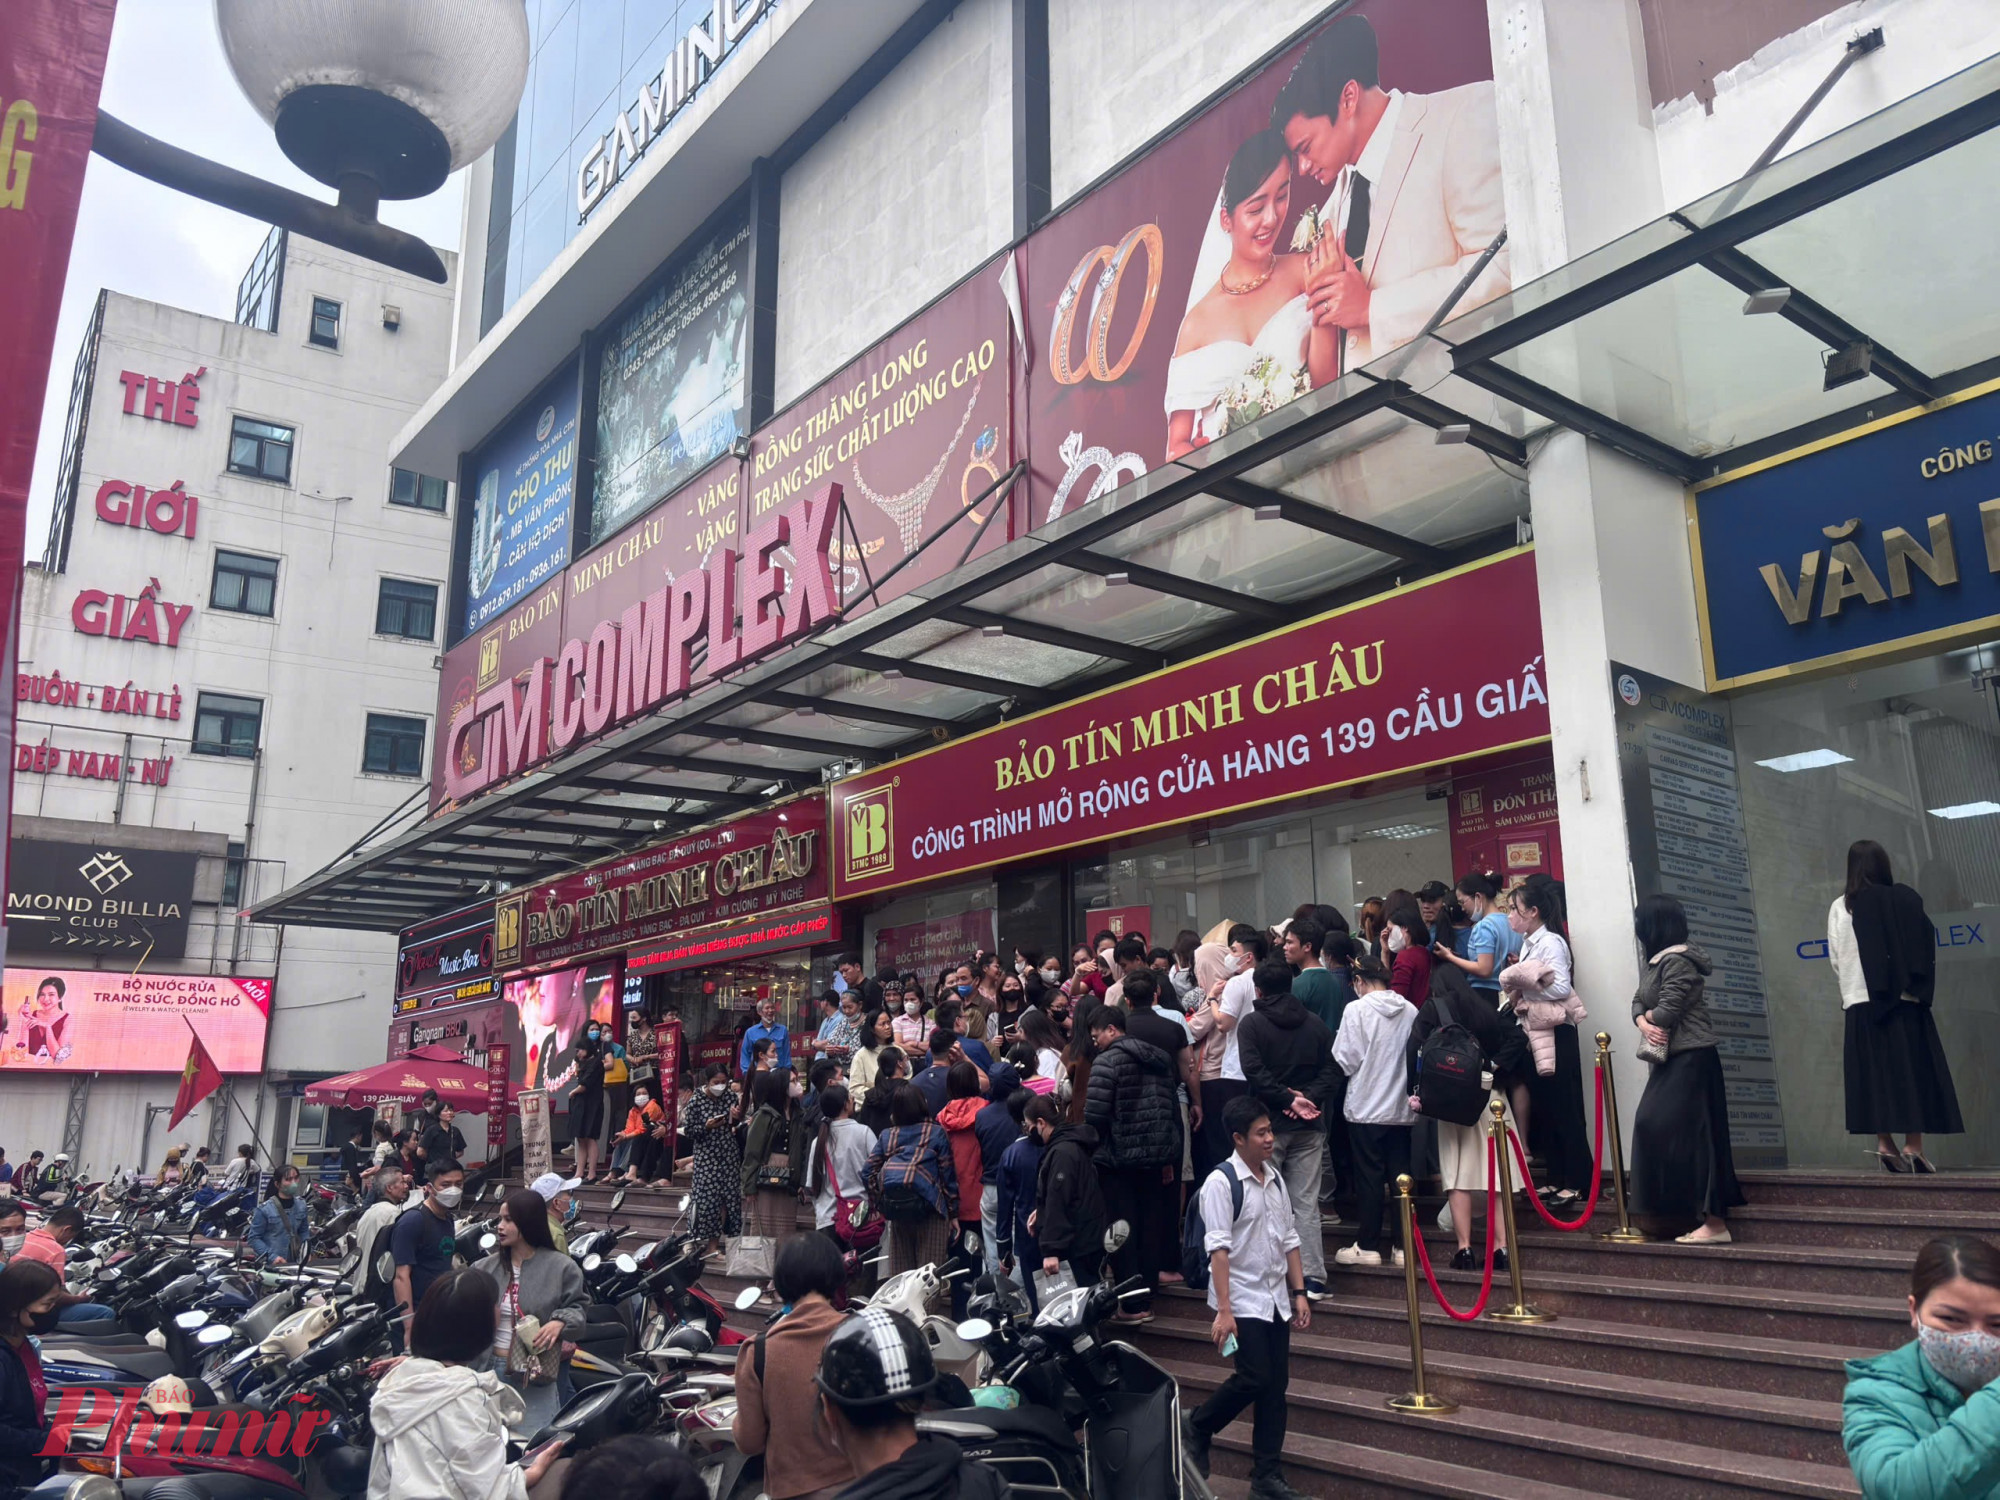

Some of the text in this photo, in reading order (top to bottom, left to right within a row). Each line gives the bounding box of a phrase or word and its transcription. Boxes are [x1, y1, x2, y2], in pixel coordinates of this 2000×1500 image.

[621, 325, 643, 350] TRUNG
[718, 238, 736, 260] CTM
[736, 225, 750, 246] PAL
[623, 269, 737, 381] 0243.7464.666 0936.496.466
[119, 366, 208, 429] THẾ
[697, 472, 738, 518] VÀNG
[754, 426, 801, 479] RỒNG
[805, 380, 867, 444] THĂNG
[871, 338, 928, 400] LONG
[695, 339, 995, 554] VÀNG TRANG SỨC CHẤT LƯỢNG CAO
[1920, 439, 1993, 479] CÔNG
[507, 470, 539, 516] CHO
[95, 479, 199, 540] GIỚI
[510, 503, 542, 542] MB VĂN
[508, 514, 565, 567] CĂN HỘ DỊCH
[508, 516, 665, 642] BẢO TÍN MINH CHÂU
[1758, 513, 1960, 626] VĂN
[552, 481, 844, 748] COMPLEX
[17, 669, 182, 721] BUÔN BÁN LẺ
[994, 640, 1385, 792] BẢO TÍN MINH CHÂU
[17, 738, 61, 773] DÉP
[67, 749, 120, 782] NAM
[911, 655, 1547, 860] CÔNG TRÌNH MỞ RỘNG CỬA HÀNG 139 CẦU GIẤ
[1493, 792, 1526, 813] ĐÓN
[1513, 812, 1536, 824] VÀNG
[851, 852, 887, 871] BTMC 1989
[526, 827, 819, 947] BẢO TÍN MINH CHÂU
[604, 871, 613, 884] TY
[8, 892, 182, 919] MOND BILLIA
[715, 903, 730, 918] KIM
[69, 916, 119, 929] CLUB
[438, 948, 480, 976] Music Box
[627, 954, 647, 969] TRUNG
[93, 991, 241, 1007] TRANG SỨC, ĐỒNG HỒ
[122, 977, 216, 994] BỘ NƯỚC RỬA
[241, 979, 268, 1003] MỚI
[156, 1006, 180, 1014] WATCH
[181, 1007, 209, 1015] CLEANER
[413, 1026, 445, 1044] Gangnam
[445, 1020, 462, 1037] BBQ
[362, 1094, 377, 1103] 139
[525, 1141, 546, 1149] TRUNG
[528, 1150, 542, 1158] TÂM
[525, 1161, 547, 1169] TRANG
[1054, 1280, 1068, 1291] MSB
[962, 1449, 993, 1458] EAD
